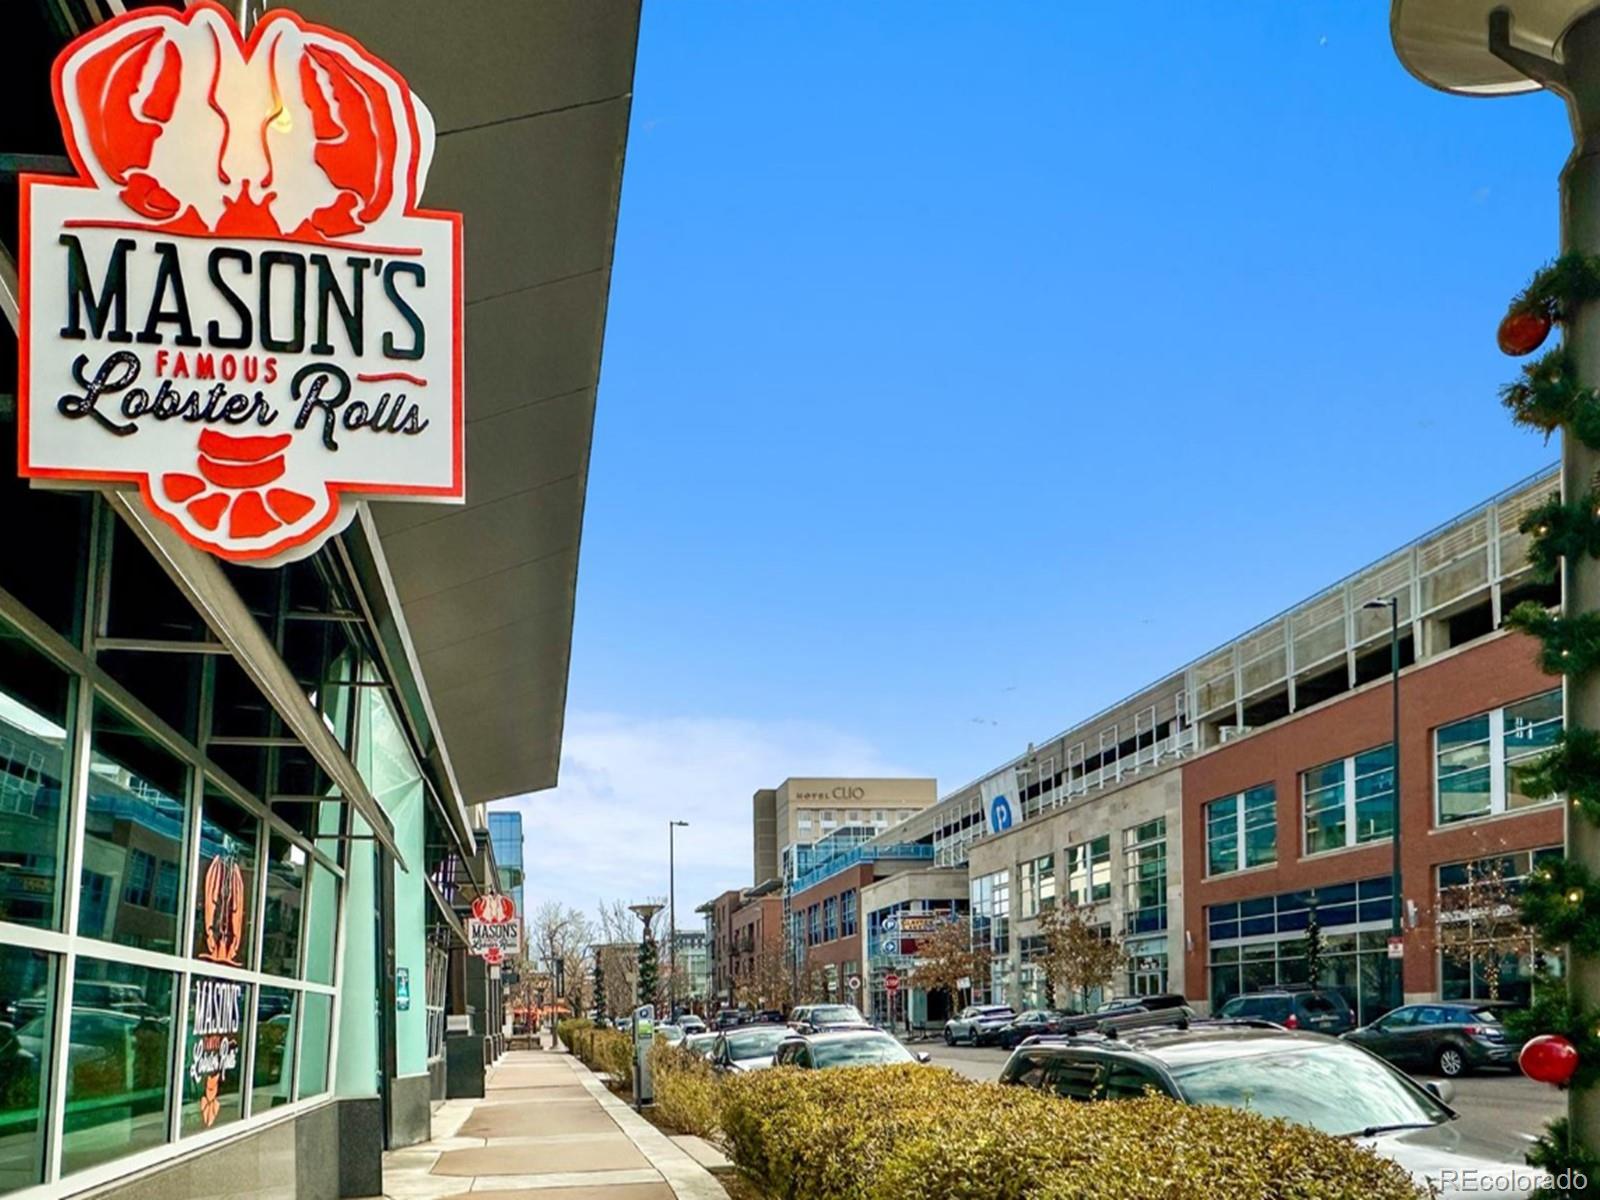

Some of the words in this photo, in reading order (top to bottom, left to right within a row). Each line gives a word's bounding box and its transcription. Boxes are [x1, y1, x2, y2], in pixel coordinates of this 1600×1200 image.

[59, 234, 427, 360] MASON'S
[57, 350, 279, 437] Lobster
[290, 362, 430, 451] Rolls
[155, 349, 279, 384] FAMOUS
[796, 791, 831, 799] HOTEL
[832, 786, 865, 800] CLIO
